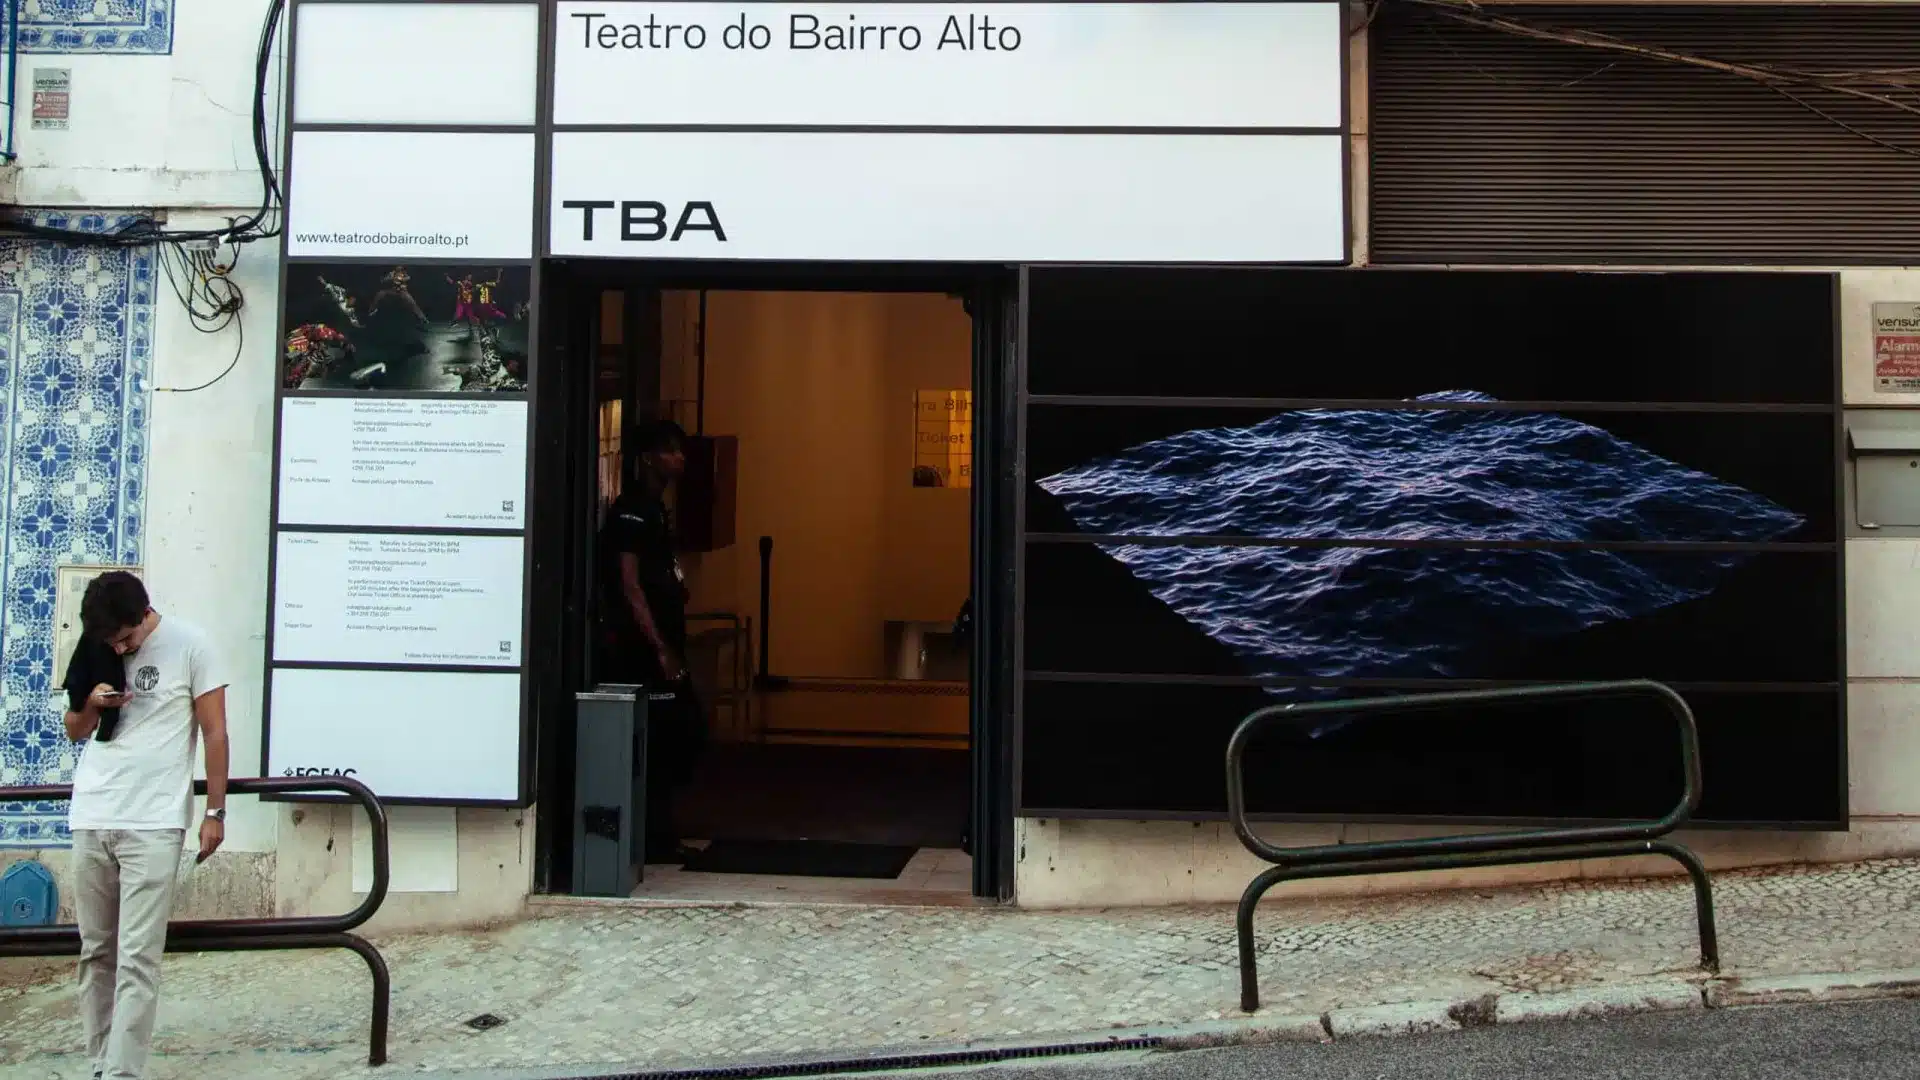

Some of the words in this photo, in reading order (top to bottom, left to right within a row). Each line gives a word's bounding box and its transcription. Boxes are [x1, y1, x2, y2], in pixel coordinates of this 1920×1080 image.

[570, 13, 706, 50] Teatro
[722, 12, 772, 50] do
[788, 14, 922, 51] Bairro
[936, 14, 1022, 51] Alto
[295, 232, 469, 248] www.teatrodobairroalto.pt
[562, 200, 728, 242] TBA
